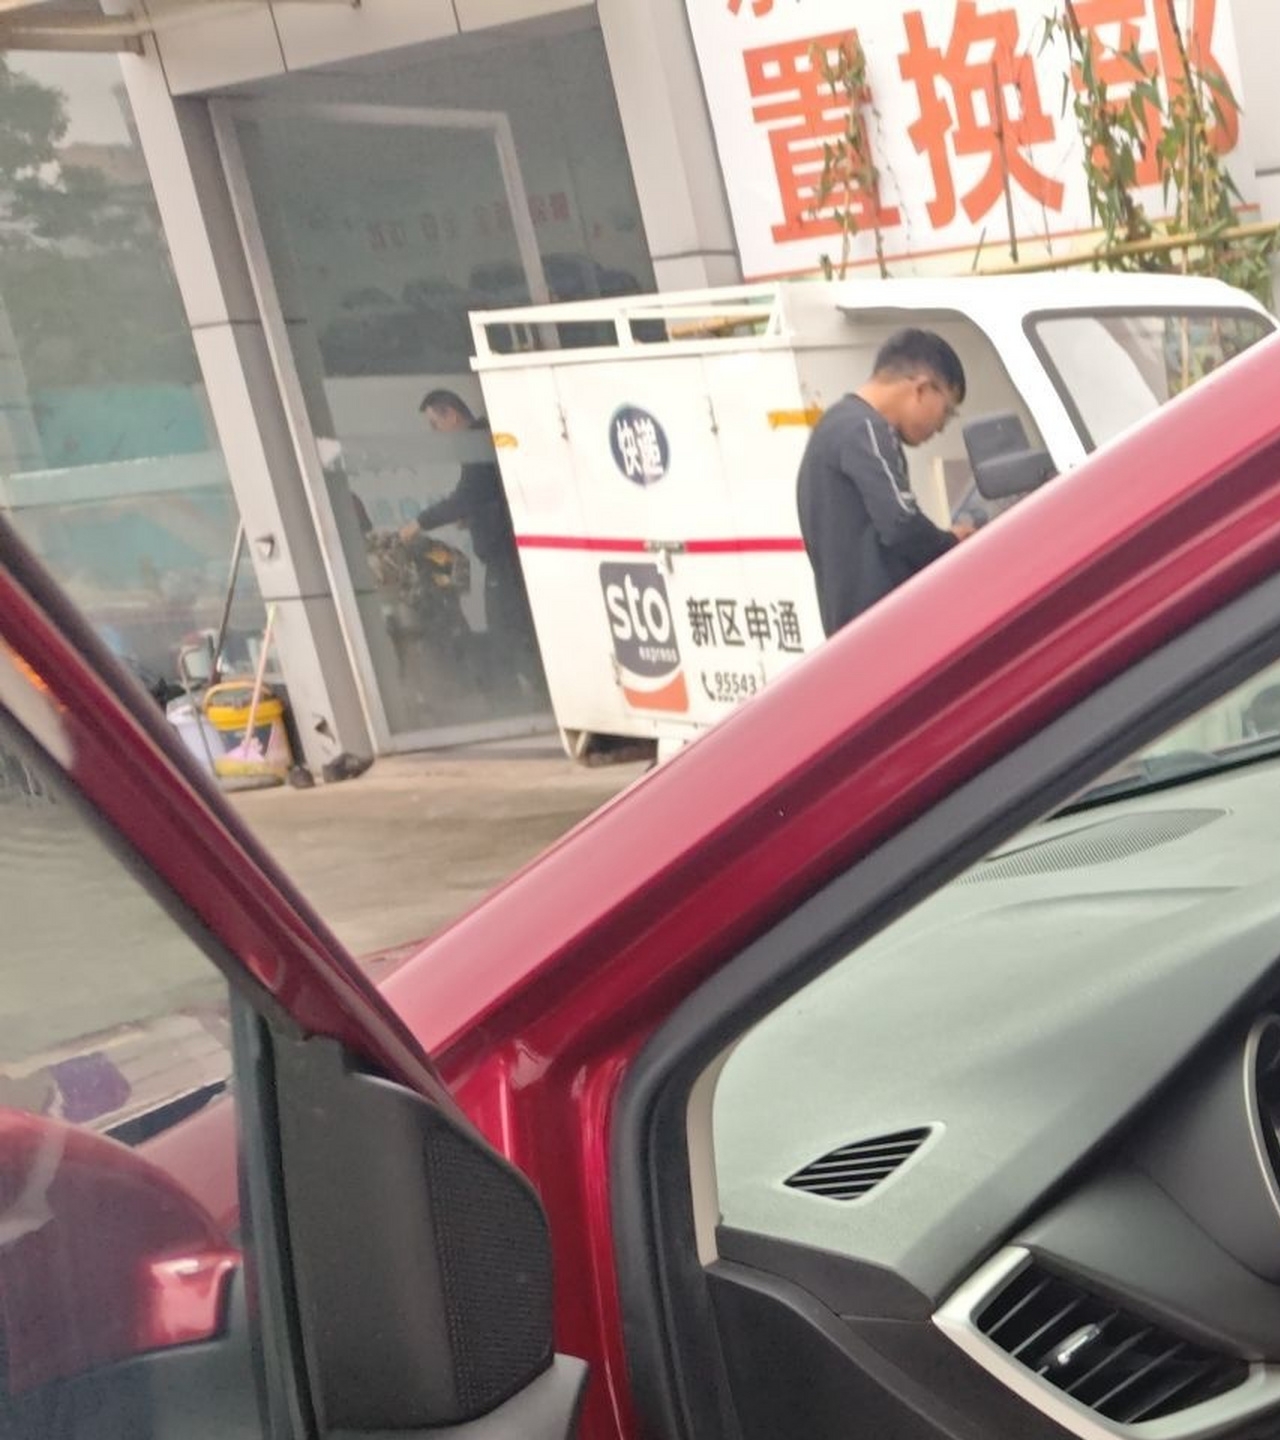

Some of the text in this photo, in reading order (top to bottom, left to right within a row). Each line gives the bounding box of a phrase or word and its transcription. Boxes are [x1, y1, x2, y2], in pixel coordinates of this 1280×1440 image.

[686, 596, 805, 653] 新区申通
[638, 646, 678, 664] express
[714, 671, 757, 696] 95543
